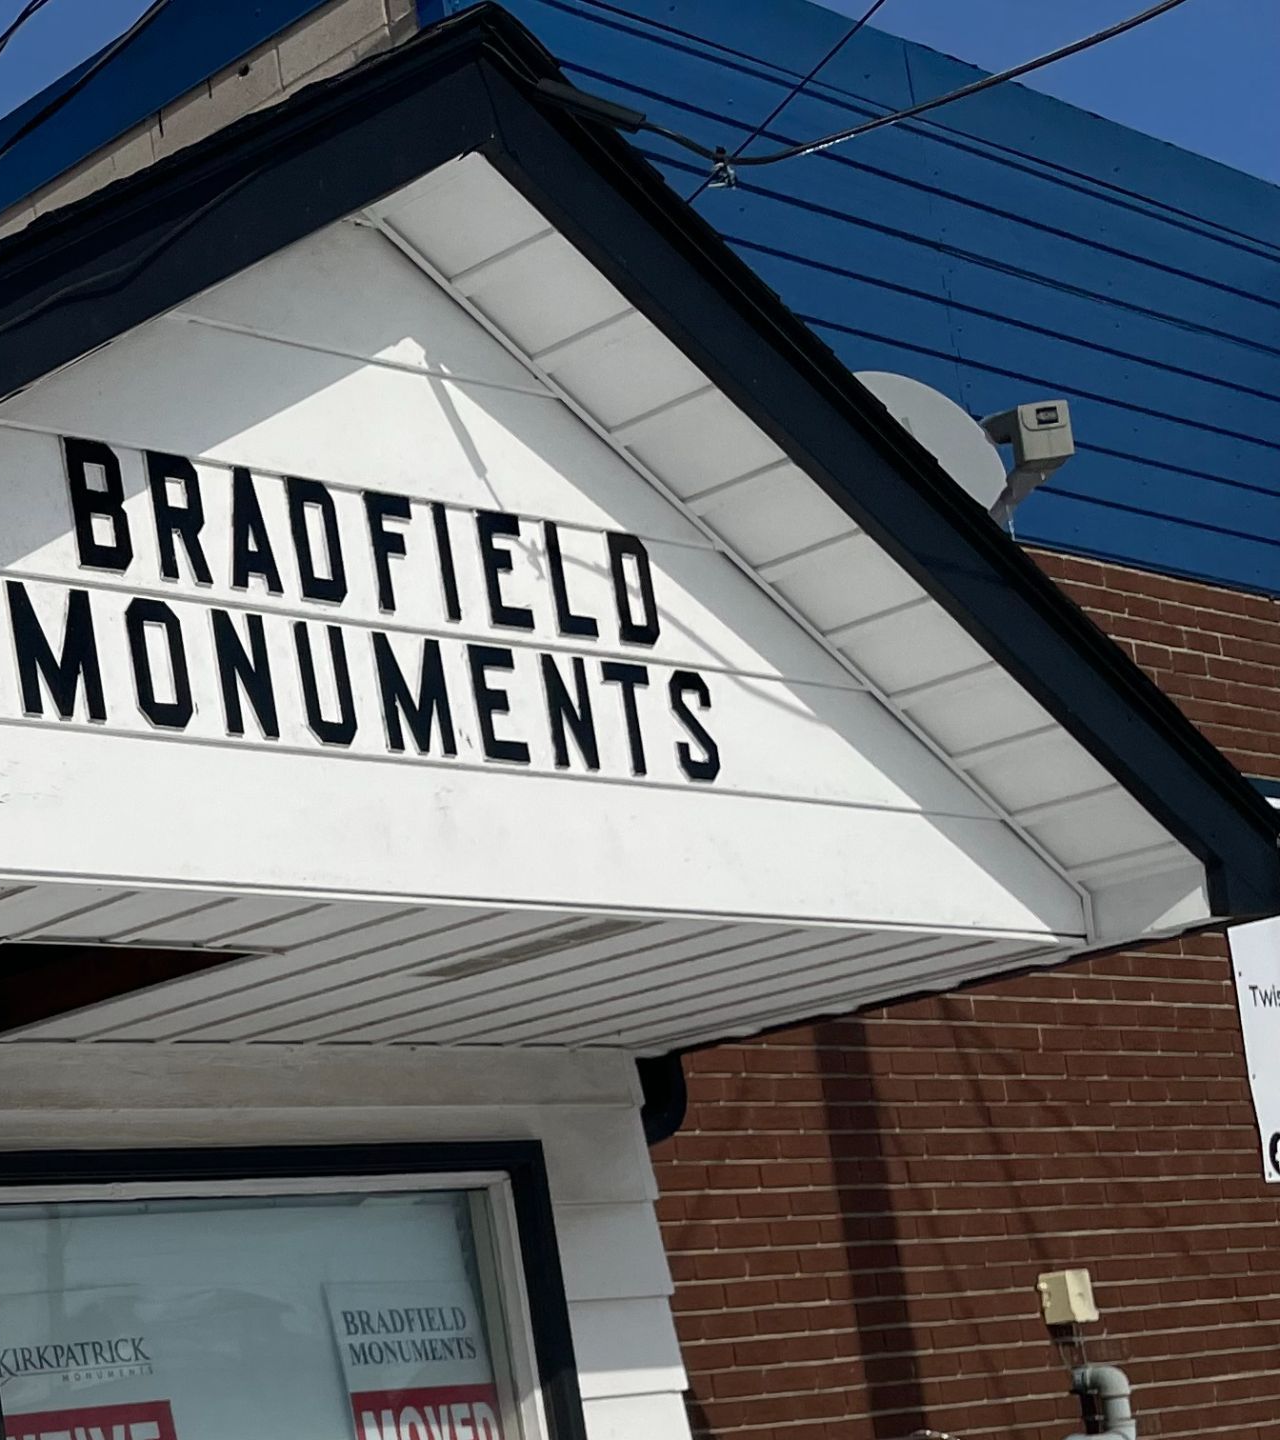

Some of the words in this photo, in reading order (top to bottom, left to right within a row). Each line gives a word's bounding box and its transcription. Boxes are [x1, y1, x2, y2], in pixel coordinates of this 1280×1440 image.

[61, 436, 660, 648] BRADFIELD
[3, 579, 721, 783] MONUMENTS
[341, 1306, 467, 1336] BRADFIELD
[348, 1336, 478, 1366] MONUMENTS
